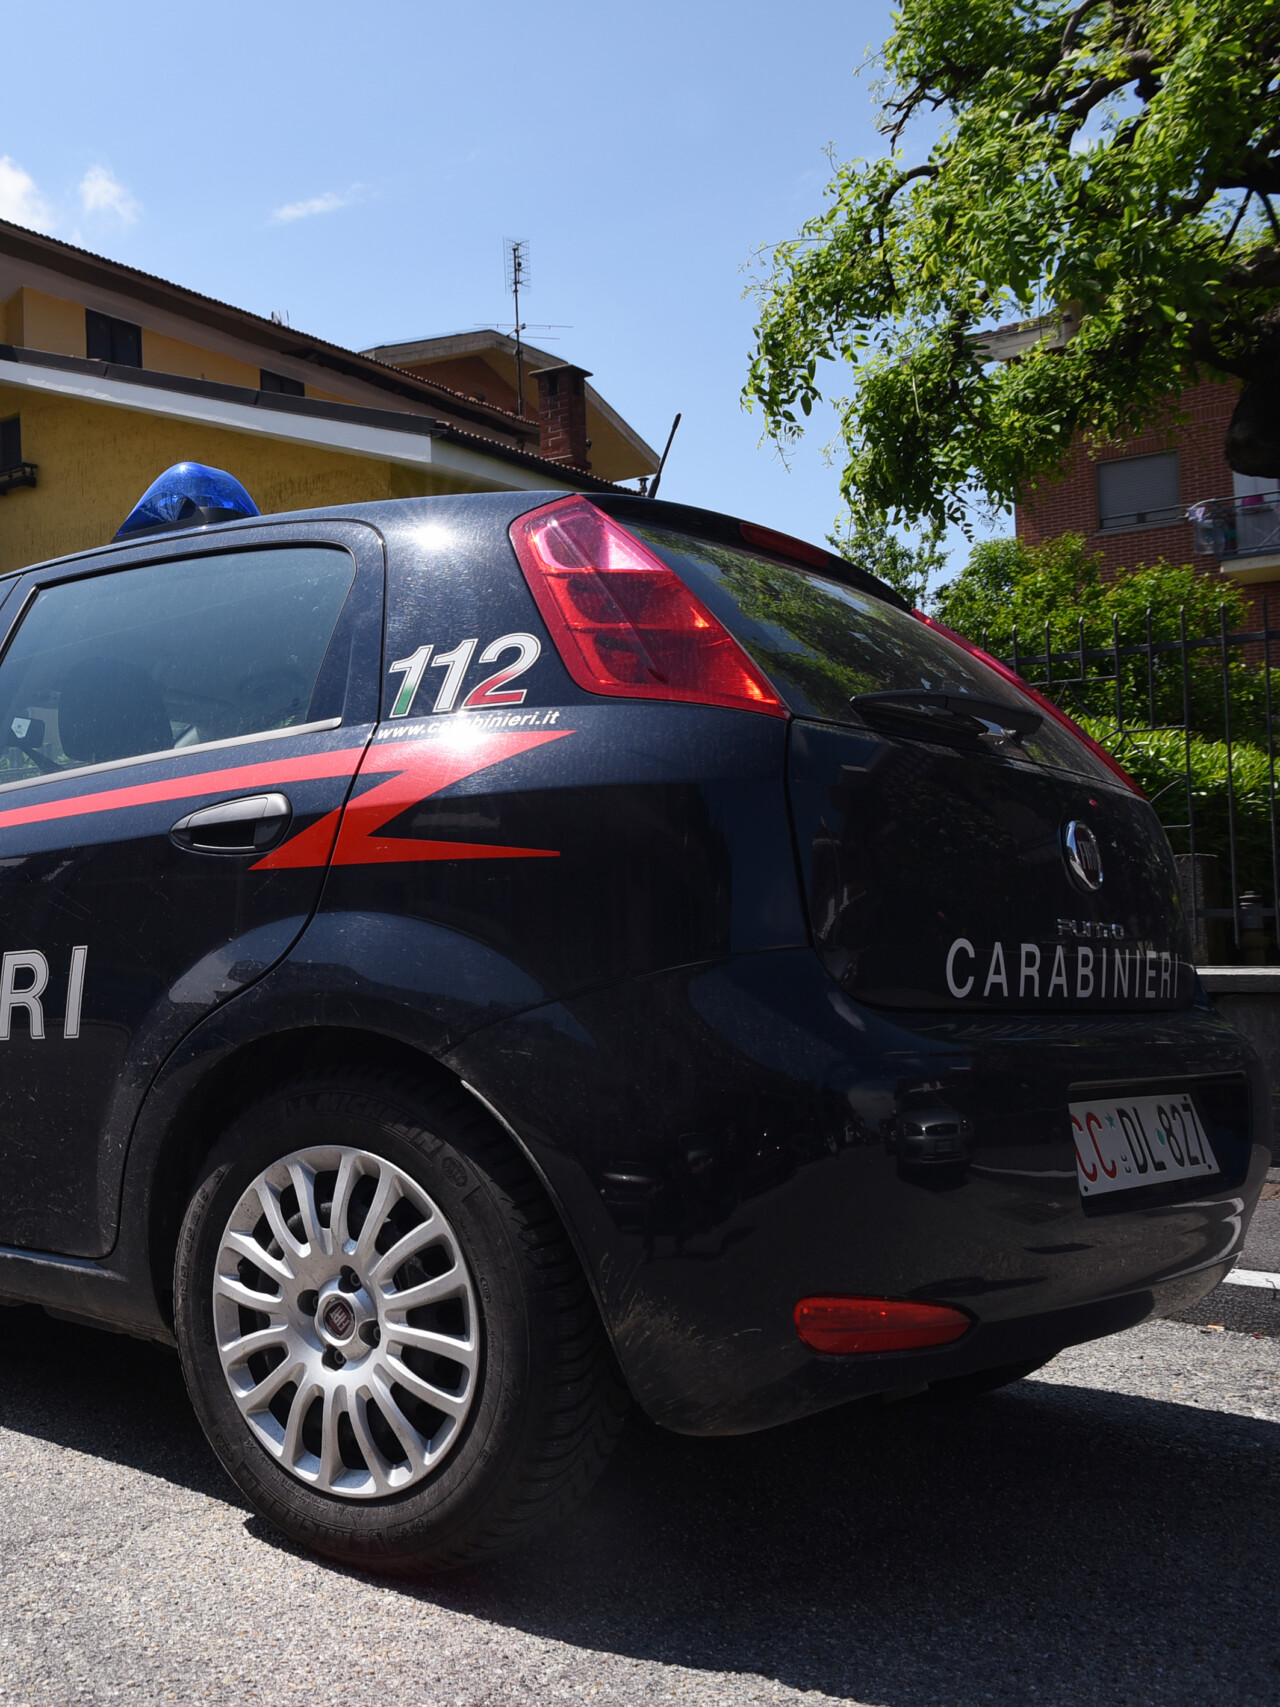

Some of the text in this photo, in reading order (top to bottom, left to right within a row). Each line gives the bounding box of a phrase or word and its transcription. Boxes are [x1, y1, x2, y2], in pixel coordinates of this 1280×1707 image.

[389, 632, 542, 718] 112
[377, 710, 560, 740] www.cabinieri.it
[945, 937, 1179, 998] CARABINIERI
[1072, 1102, 1208, 1182] CC DL 827
